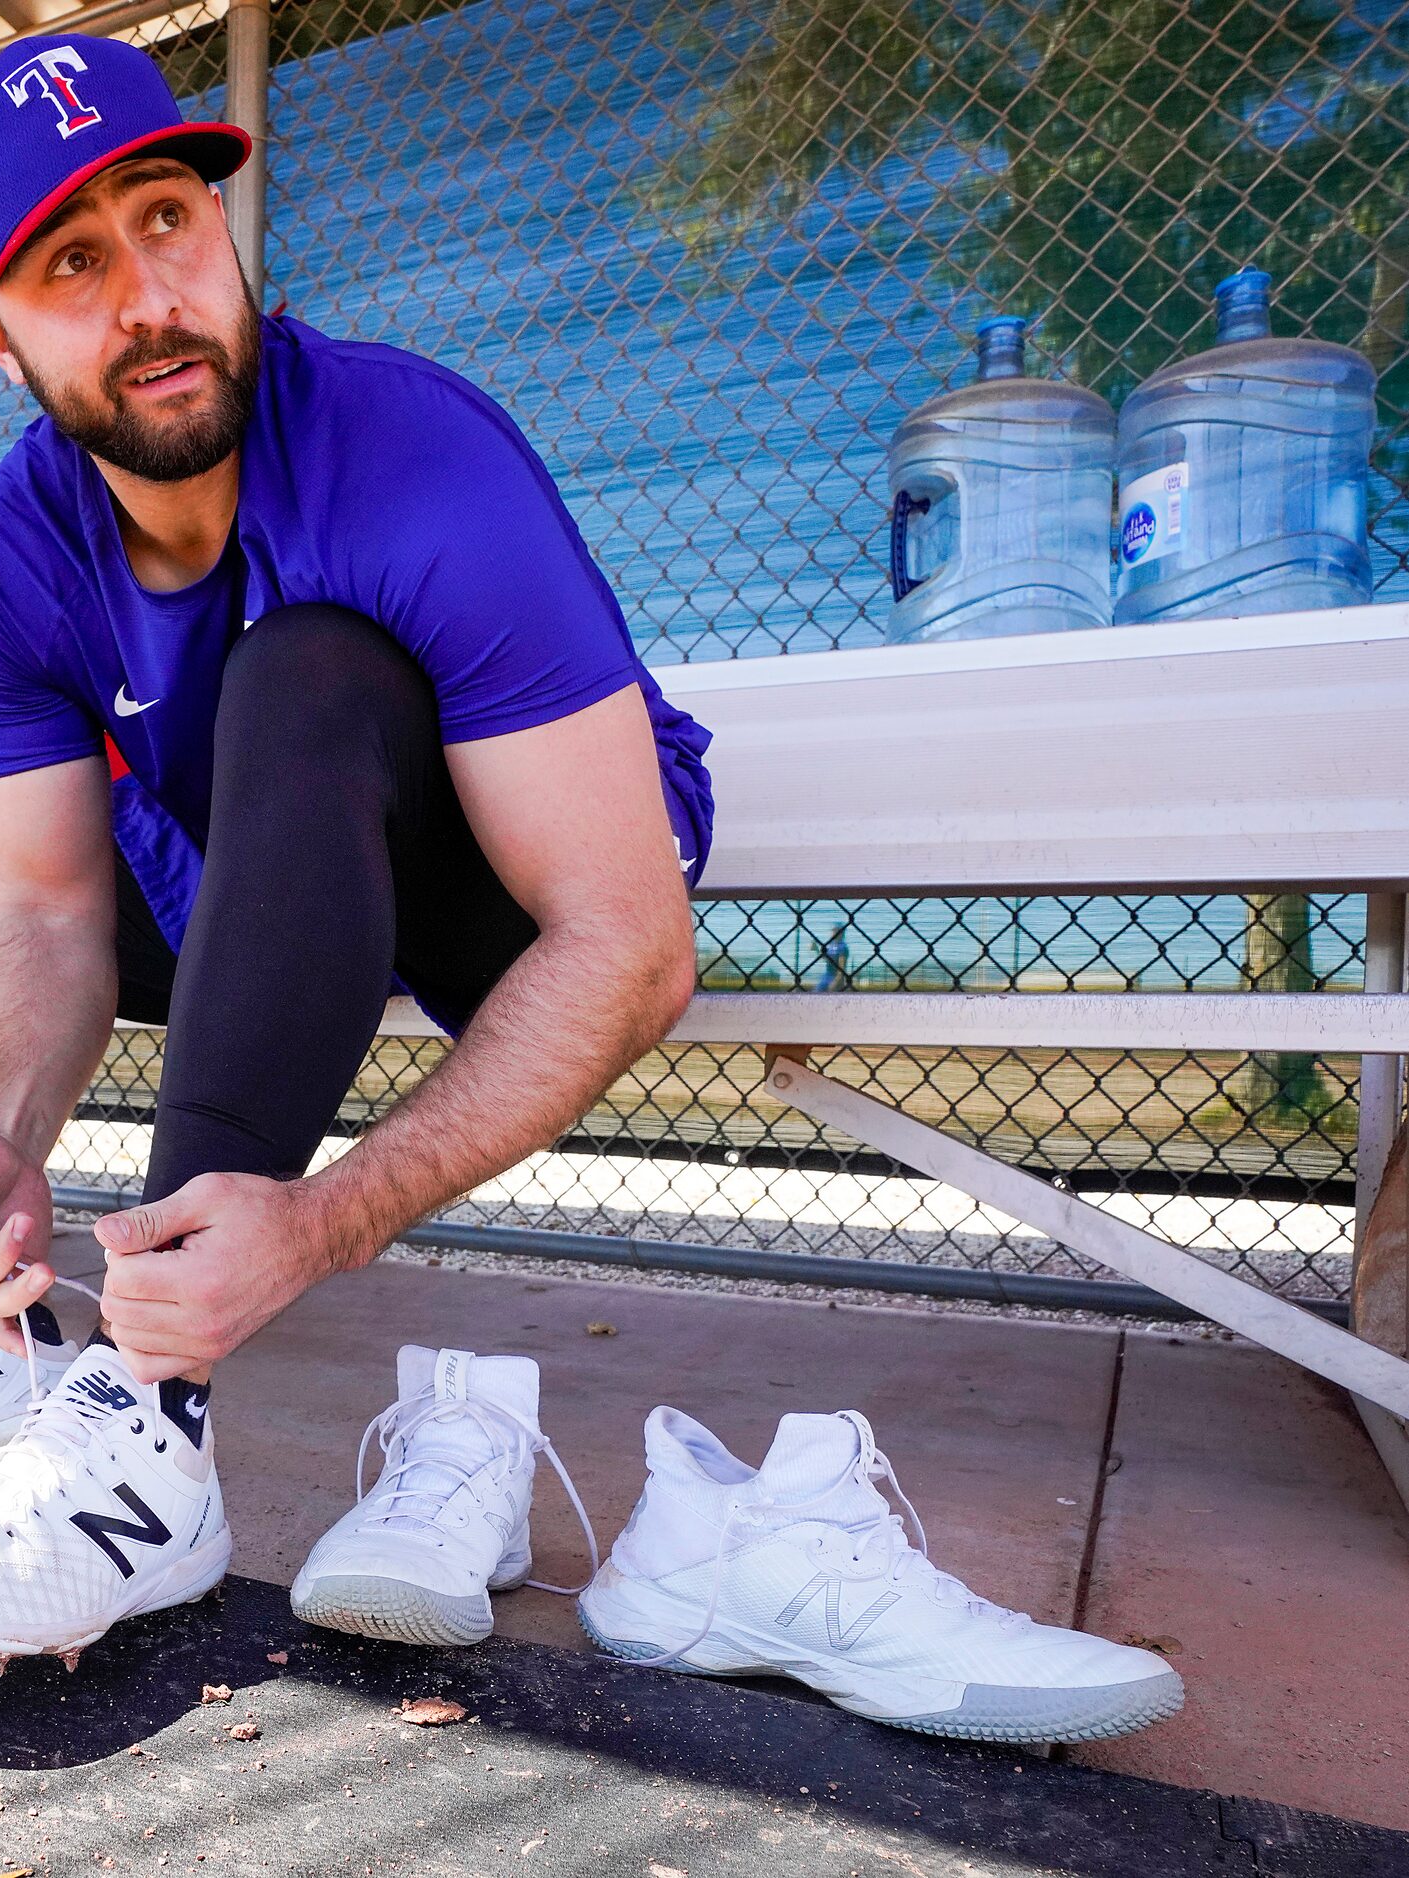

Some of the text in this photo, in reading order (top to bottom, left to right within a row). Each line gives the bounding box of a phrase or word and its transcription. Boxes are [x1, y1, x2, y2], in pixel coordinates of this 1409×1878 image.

[1, 45, 102, 140] T
[65, 1480, 175, 1583] N
[774, 1570, 906, 1652] N
